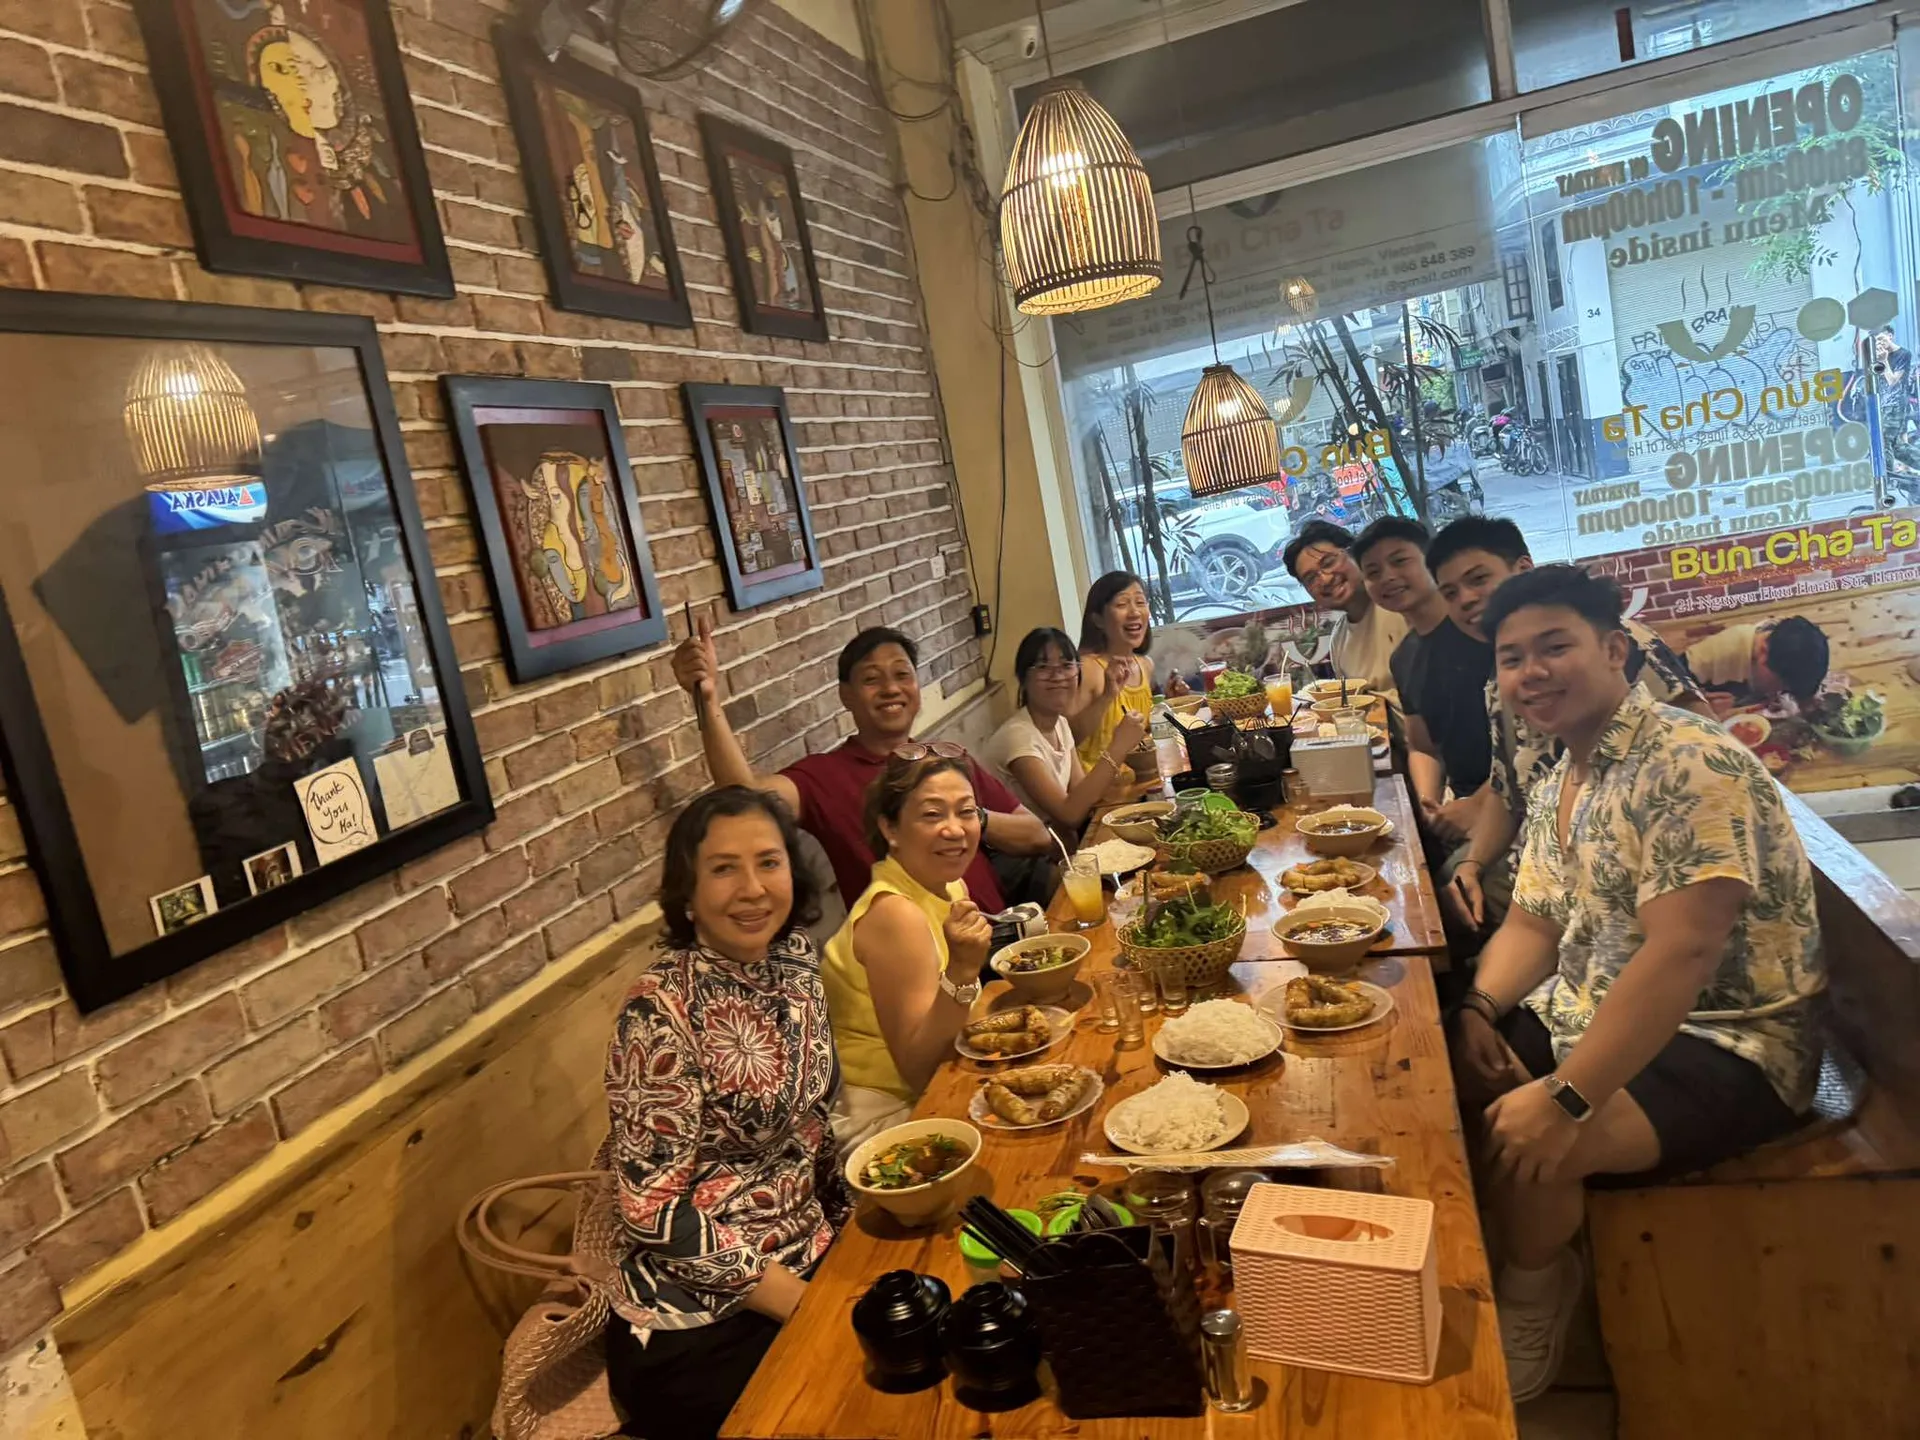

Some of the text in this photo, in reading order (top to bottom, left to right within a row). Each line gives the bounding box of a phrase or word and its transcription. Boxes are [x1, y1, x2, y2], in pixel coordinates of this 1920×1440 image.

[1587, 307, 1601, 319] 34
[1670, 544, 1752, 580] Bun
[1765, 528, 1853, 566] Cha
[1860, 515, 1918, 551] Ta
[310, 780, 345, 811] Thank
